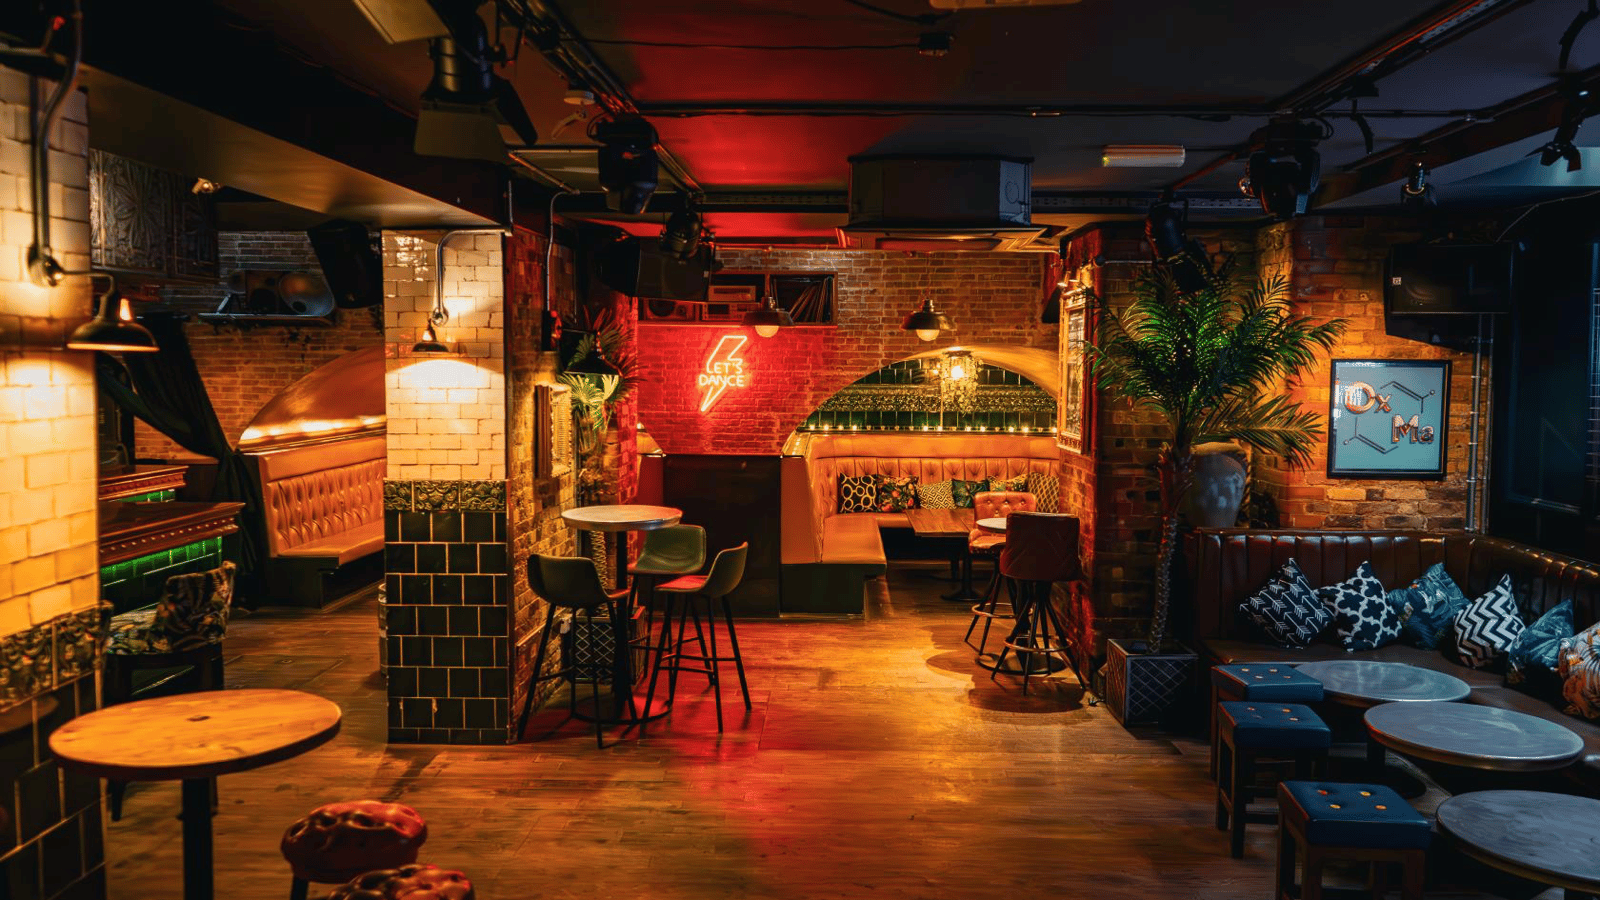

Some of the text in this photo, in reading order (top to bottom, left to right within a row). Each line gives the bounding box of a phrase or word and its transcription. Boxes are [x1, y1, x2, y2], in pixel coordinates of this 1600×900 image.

[706, 361, 743, 374] LET'S
[698, 374, 745, 387] DANCE
[1344, 381, 1392, 414] Ox
